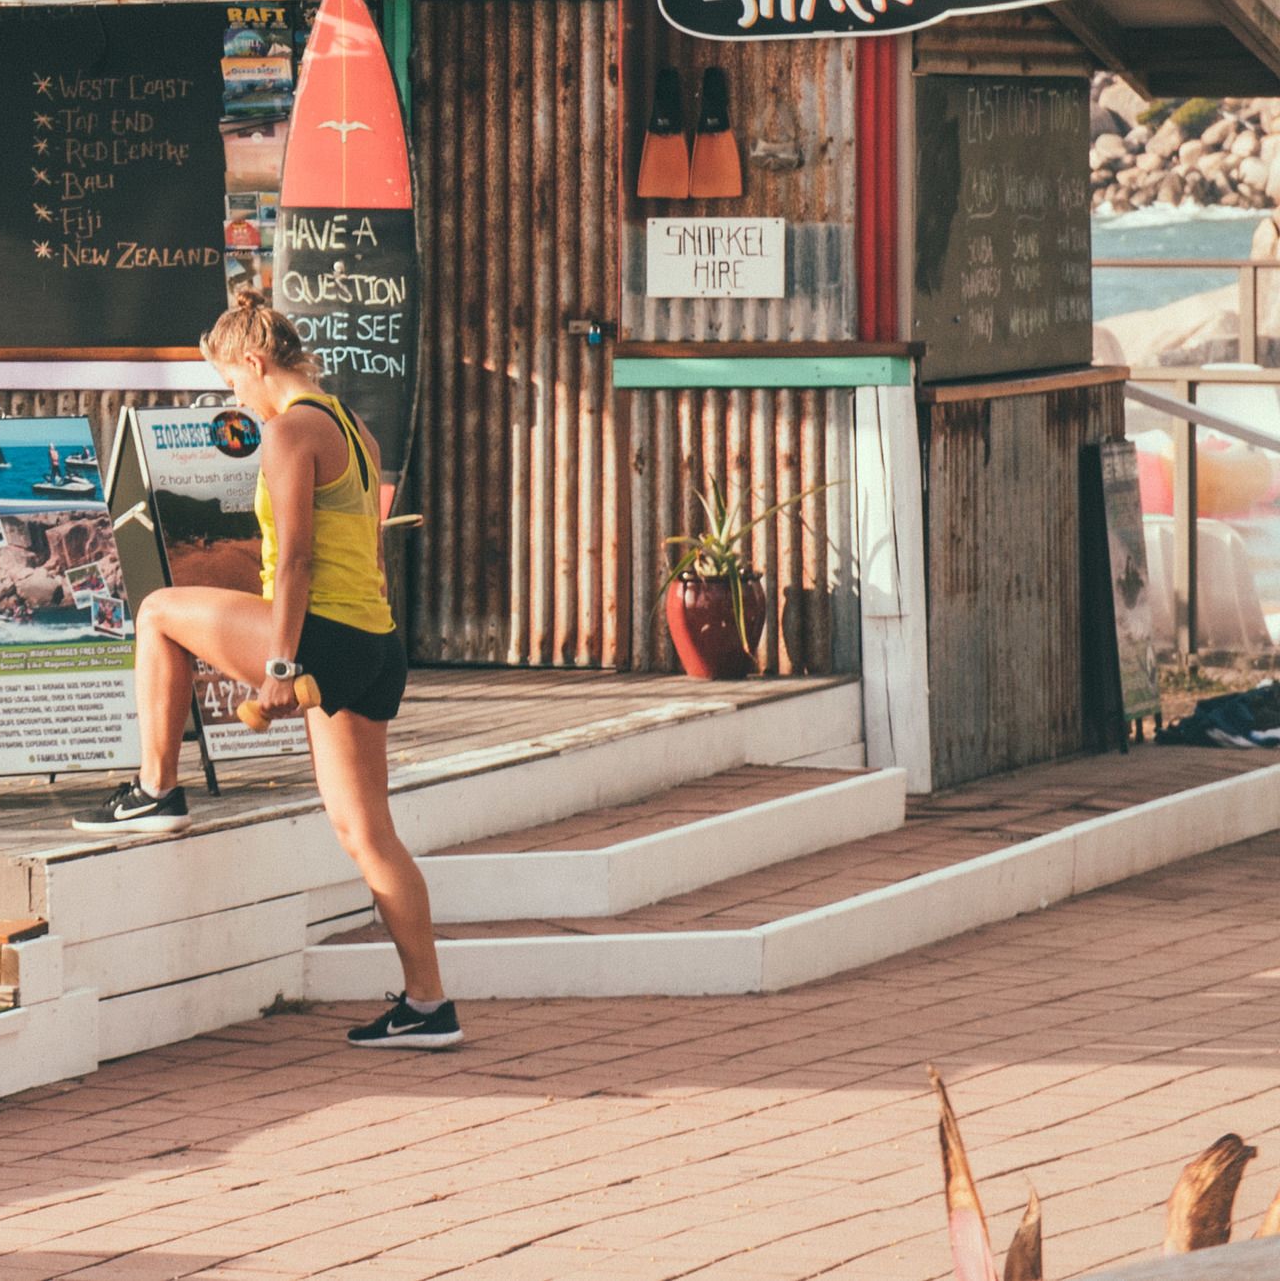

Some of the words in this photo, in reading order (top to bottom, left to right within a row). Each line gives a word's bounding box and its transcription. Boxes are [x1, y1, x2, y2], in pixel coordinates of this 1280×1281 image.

[226, 7, 286, 23] RAFT
[59, 71, 120, 101] WEST
[130, 74, 193, 102] COAST
[58, 106, 98, 133] TOP
[111, 110, 154, 135] END
[967, 85, 1004, 144] EAST
[65, 138, 108, 168] RED
[113, 139, 190, 165] CENTRE
[282, 214, 348, 251] HAVE
[352, 216, 378, 246] A
[663, 224, 770, 257] SNORKEL
[62, 240, 110, 268] NEW
[116, 241, 220, 269] ZEALAND
[282, 271, 406, 307] QUESTION
[694, 260, 744, 289] HIRE
[357, 313, 403, 344] SEE
[152, 420, 228, 449] HORSESHOE
[160, 475, 166, 486] 2
[168, 475, 192, 485] hour
[195, 472, 220, 484] bush
[223, 472, 242, 482] and
[36, 752, 69, 762] FAMILIES
[71, 751, 107, 761] WELCOME
